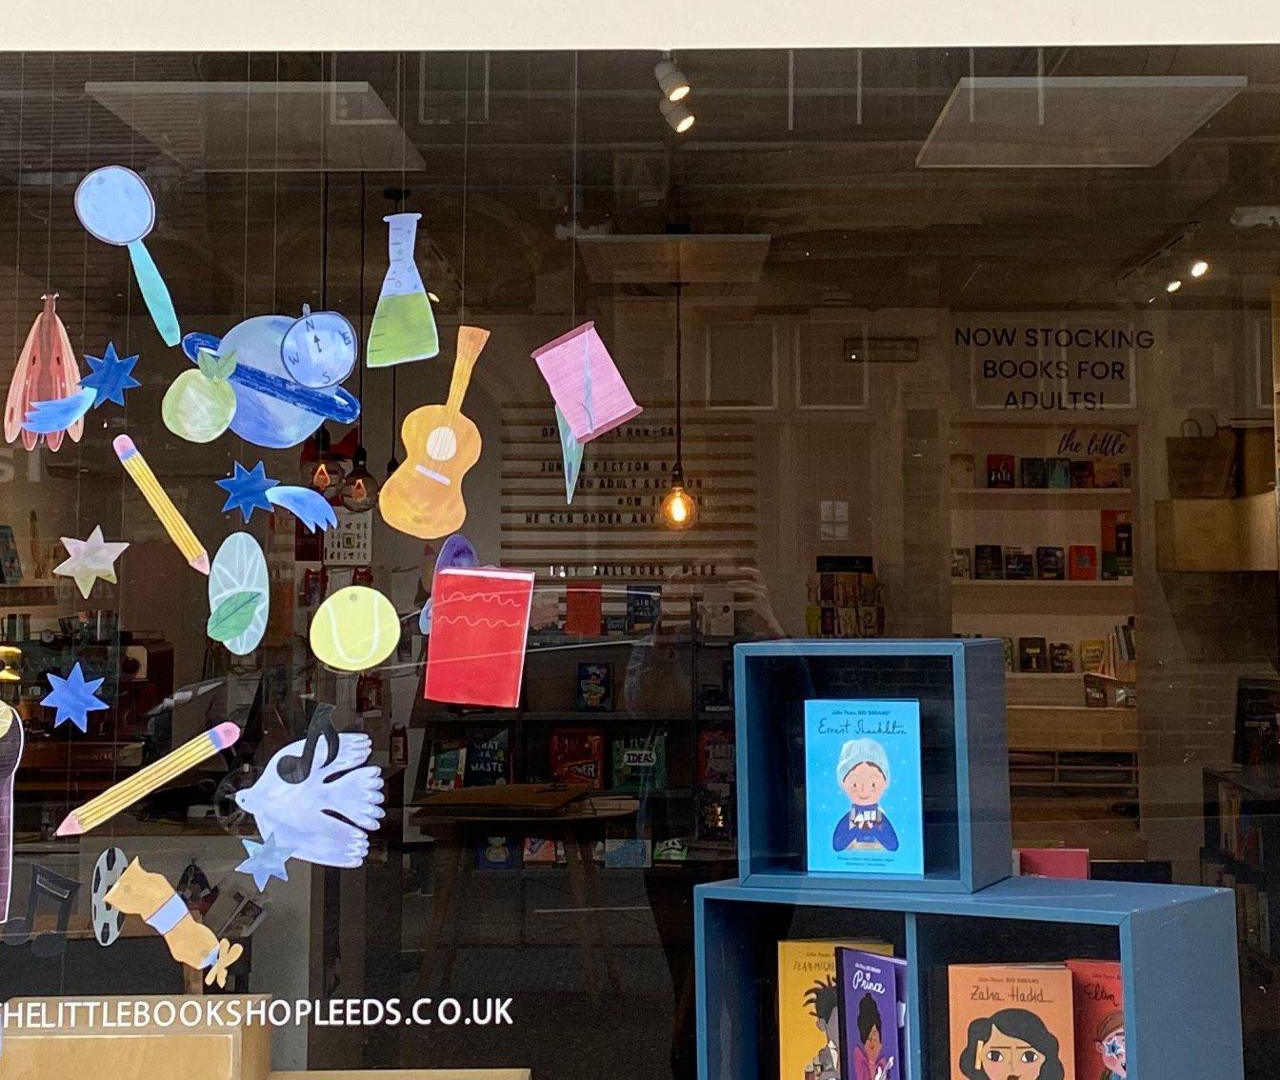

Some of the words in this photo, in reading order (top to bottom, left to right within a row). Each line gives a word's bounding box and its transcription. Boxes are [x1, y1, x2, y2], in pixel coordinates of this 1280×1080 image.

[954, 327, 1017, 347] NOW
[1024, 328, 1155, 349] STOCKING
[983, 359, 1069, 380] BOOKS
[1077, 360, 1126, 380] FOR
[1004, 390, 1105, 411] ADULTS!
[1057, 427, 1082, 455] the
[1087, 431, 1129, 457] little
[592, 462, 650, 471] FICTION
[599, 479, 637, 488] ADULT
[525, 514, 539, 524] WE
[582, 514, 622, 524] ORDER
[631, 514, 656, 524] ANY
[817, 717, 851, 735] Ernest
[625, 752, 655, 764] IDEAS
[469, 762, 503, 774] WASTE
[852, 969, 886, 994] Prince
[970, 985, 1005, 1002] Zaha
[1008, 985, 1054, 1003] Hadid
